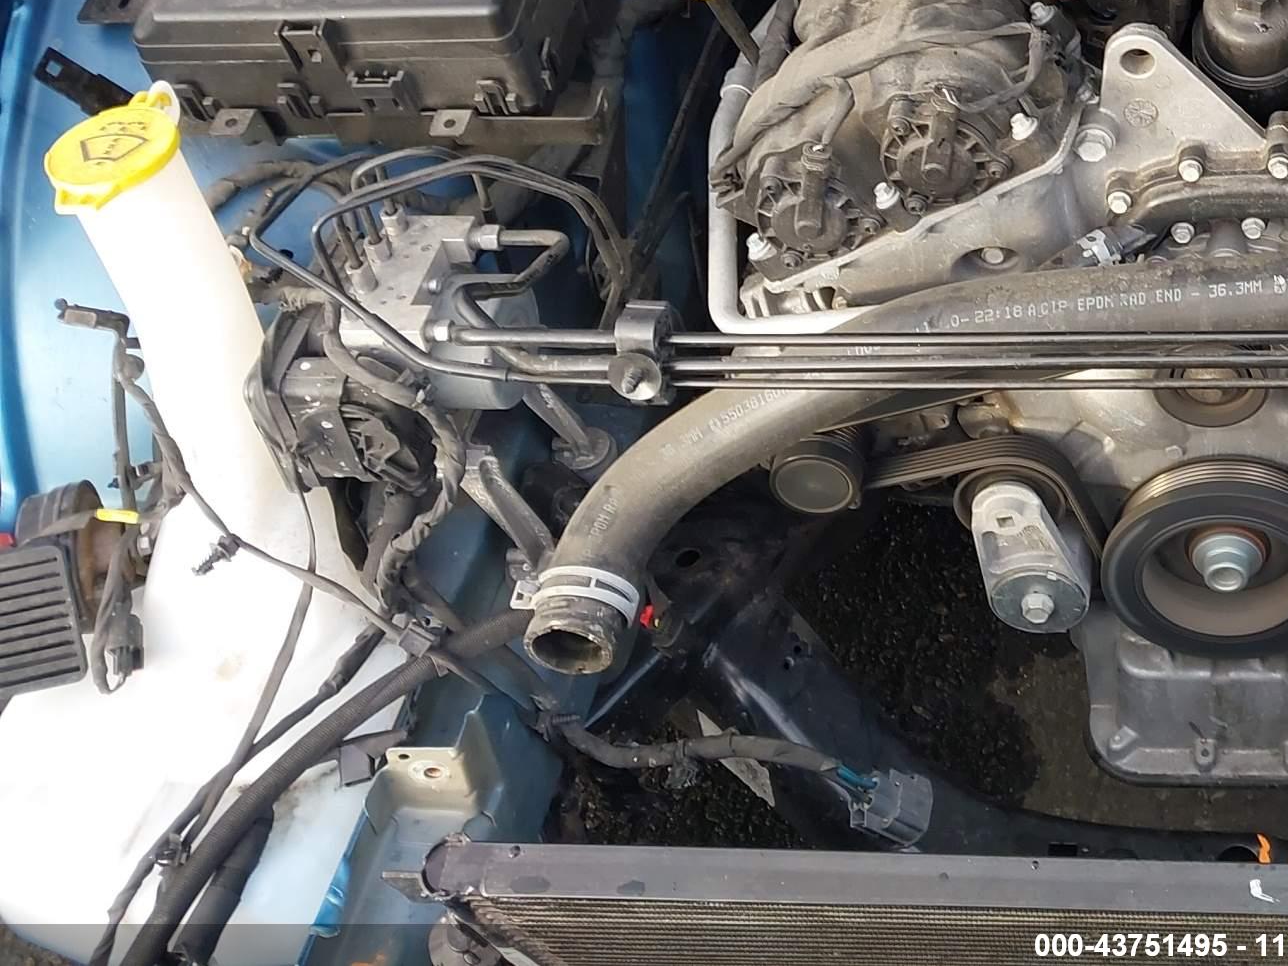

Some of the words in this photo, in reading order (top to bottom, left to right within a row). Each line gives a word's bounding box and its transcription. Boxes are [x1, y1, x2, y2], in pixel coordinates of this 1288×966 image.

[974, 305, 1023, 324] 22:18
[1155, 288, 1183, 304] END
[1207, 280, 1264, 299] 36.3MM
